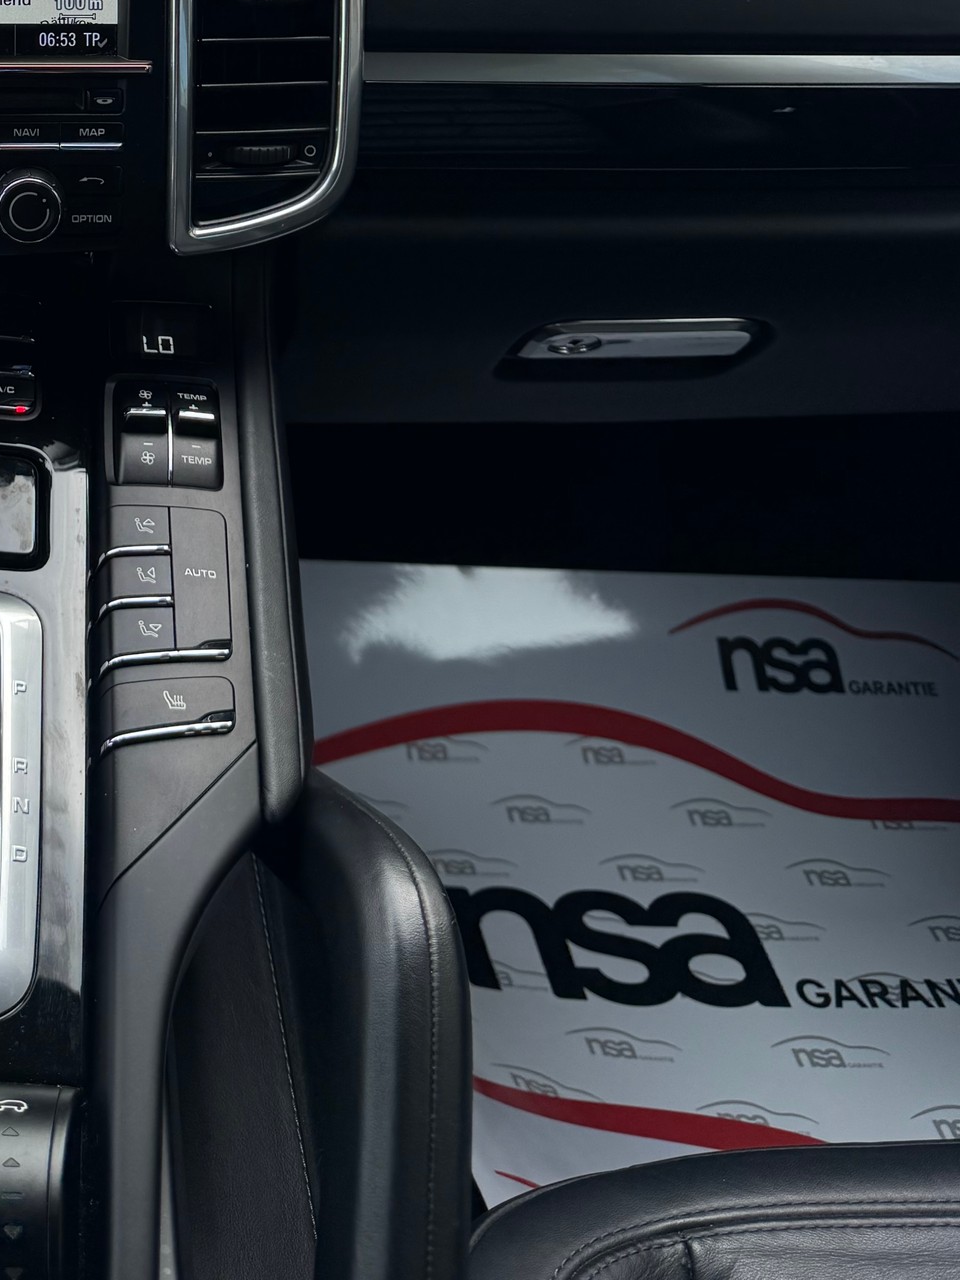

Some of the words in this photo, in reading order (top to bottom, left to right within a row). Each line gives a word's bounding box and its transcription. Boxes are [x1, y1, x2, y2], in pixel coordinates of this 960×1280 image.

[39, 32, 76, 47] 06:53
[83, 32, 101, 47] TP
[13, 127, 40, 137] NAVI
[79, 127, 105, 137] MAP
[71, 214, 112, 224] OPTION
[177, 392, 207, 401] TEMP
[181, 455, 212, 466] TEMP
[184, 567, 217, 579] AUTO
[717, 636, 845, 694] nsa
[848, 679, 939, 696] GARANTIE
[13, 680, 27, 695] P
[13, 758, 28, 774] R
[13, 797, 29, 814] N
[13, 846, 27, 863] D
[448, 886, 791, 1008] nsa
[792, 1048, 847, 1069] nsa
